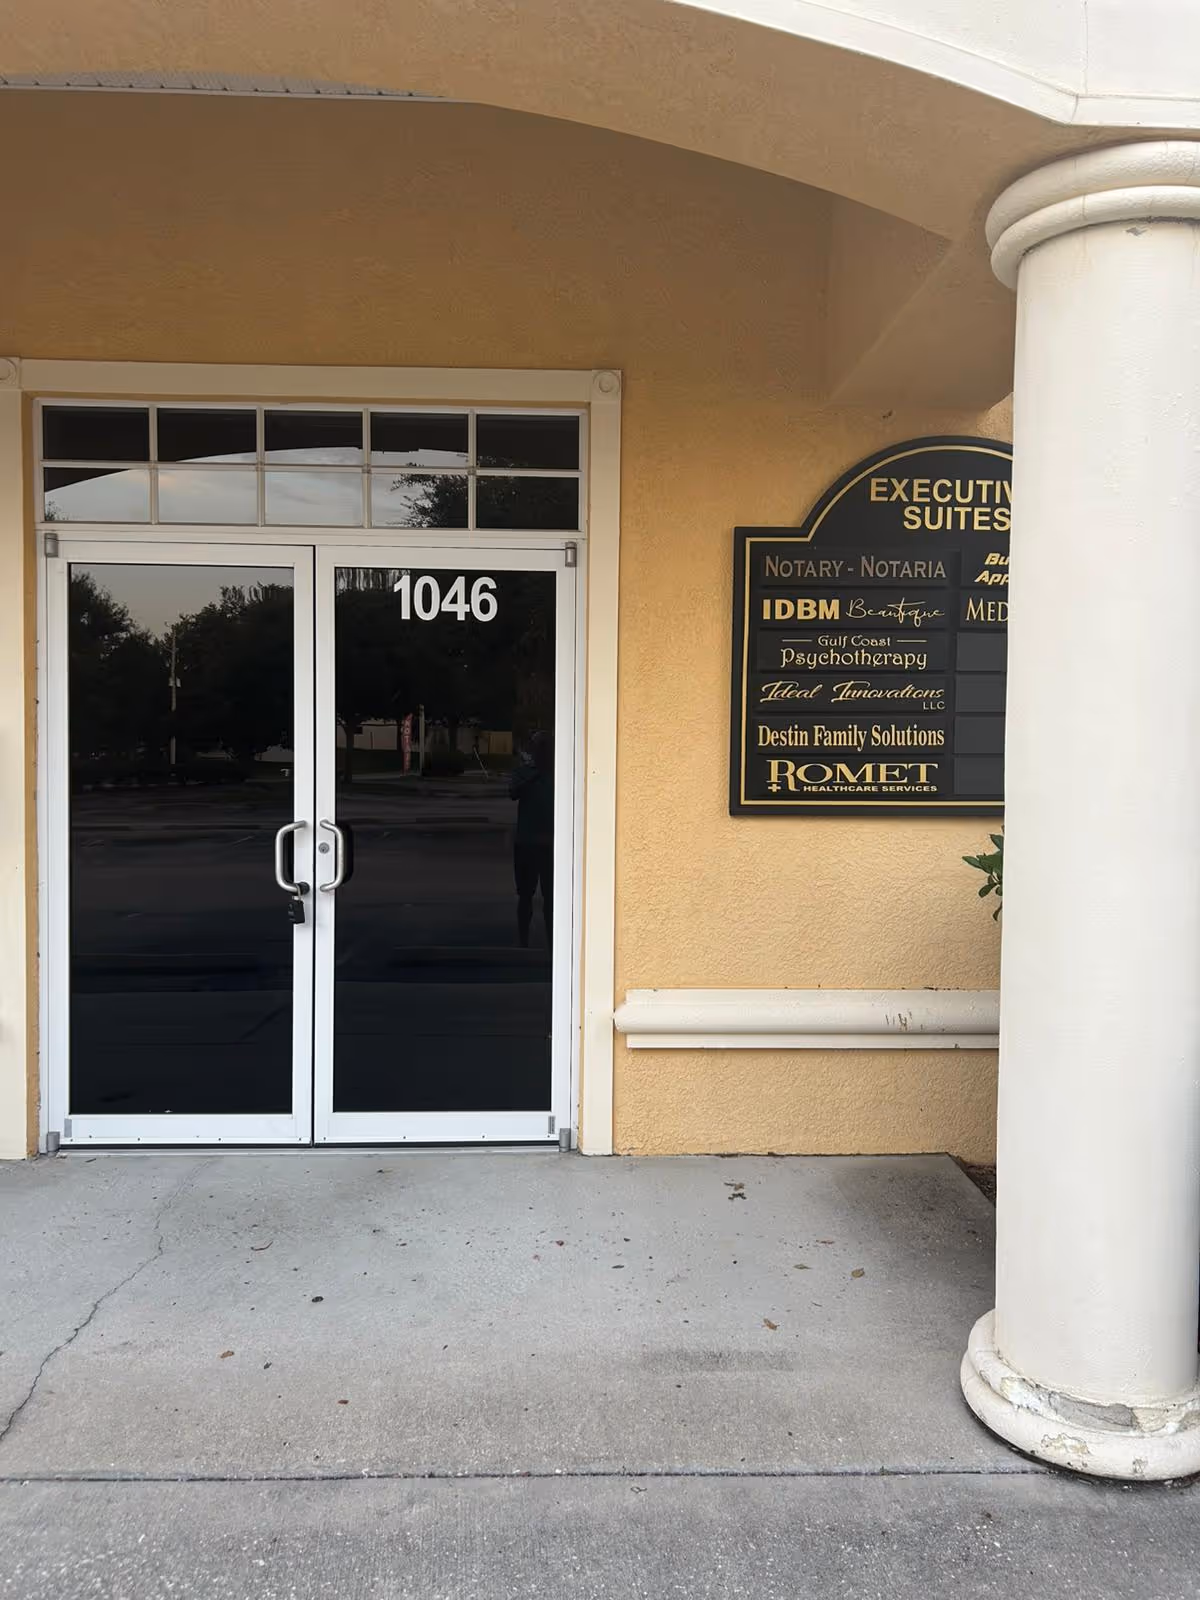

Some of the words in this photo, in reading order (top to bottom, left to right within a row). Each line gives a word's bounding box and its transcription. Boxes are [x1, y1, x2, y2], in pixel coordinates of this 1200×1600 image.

[903, 506, 1011, 531] SUITES
[765, 555, 844, 578] NOTARY
[861, 556, 946, 578] NOTARIA
[393, 574, 499, 622] 1046
[762, 599, 840, 620] IDBM
[817, 635, 848, 648] Gulf
[851, 635, 891, 647] Coast
[780, 648, 928, 670] Psychotherapy
[760, 680, 823, 703] Ideal
[831, 680, 945, 703] Innovations
[923, 701, 945, 710] LLC
[758, 724, 809, 746] Destin
[813, 724, 867, 752] Family
[871, 724, 945, 746] Solutions
[766, 759, 939, 792] ROMET
